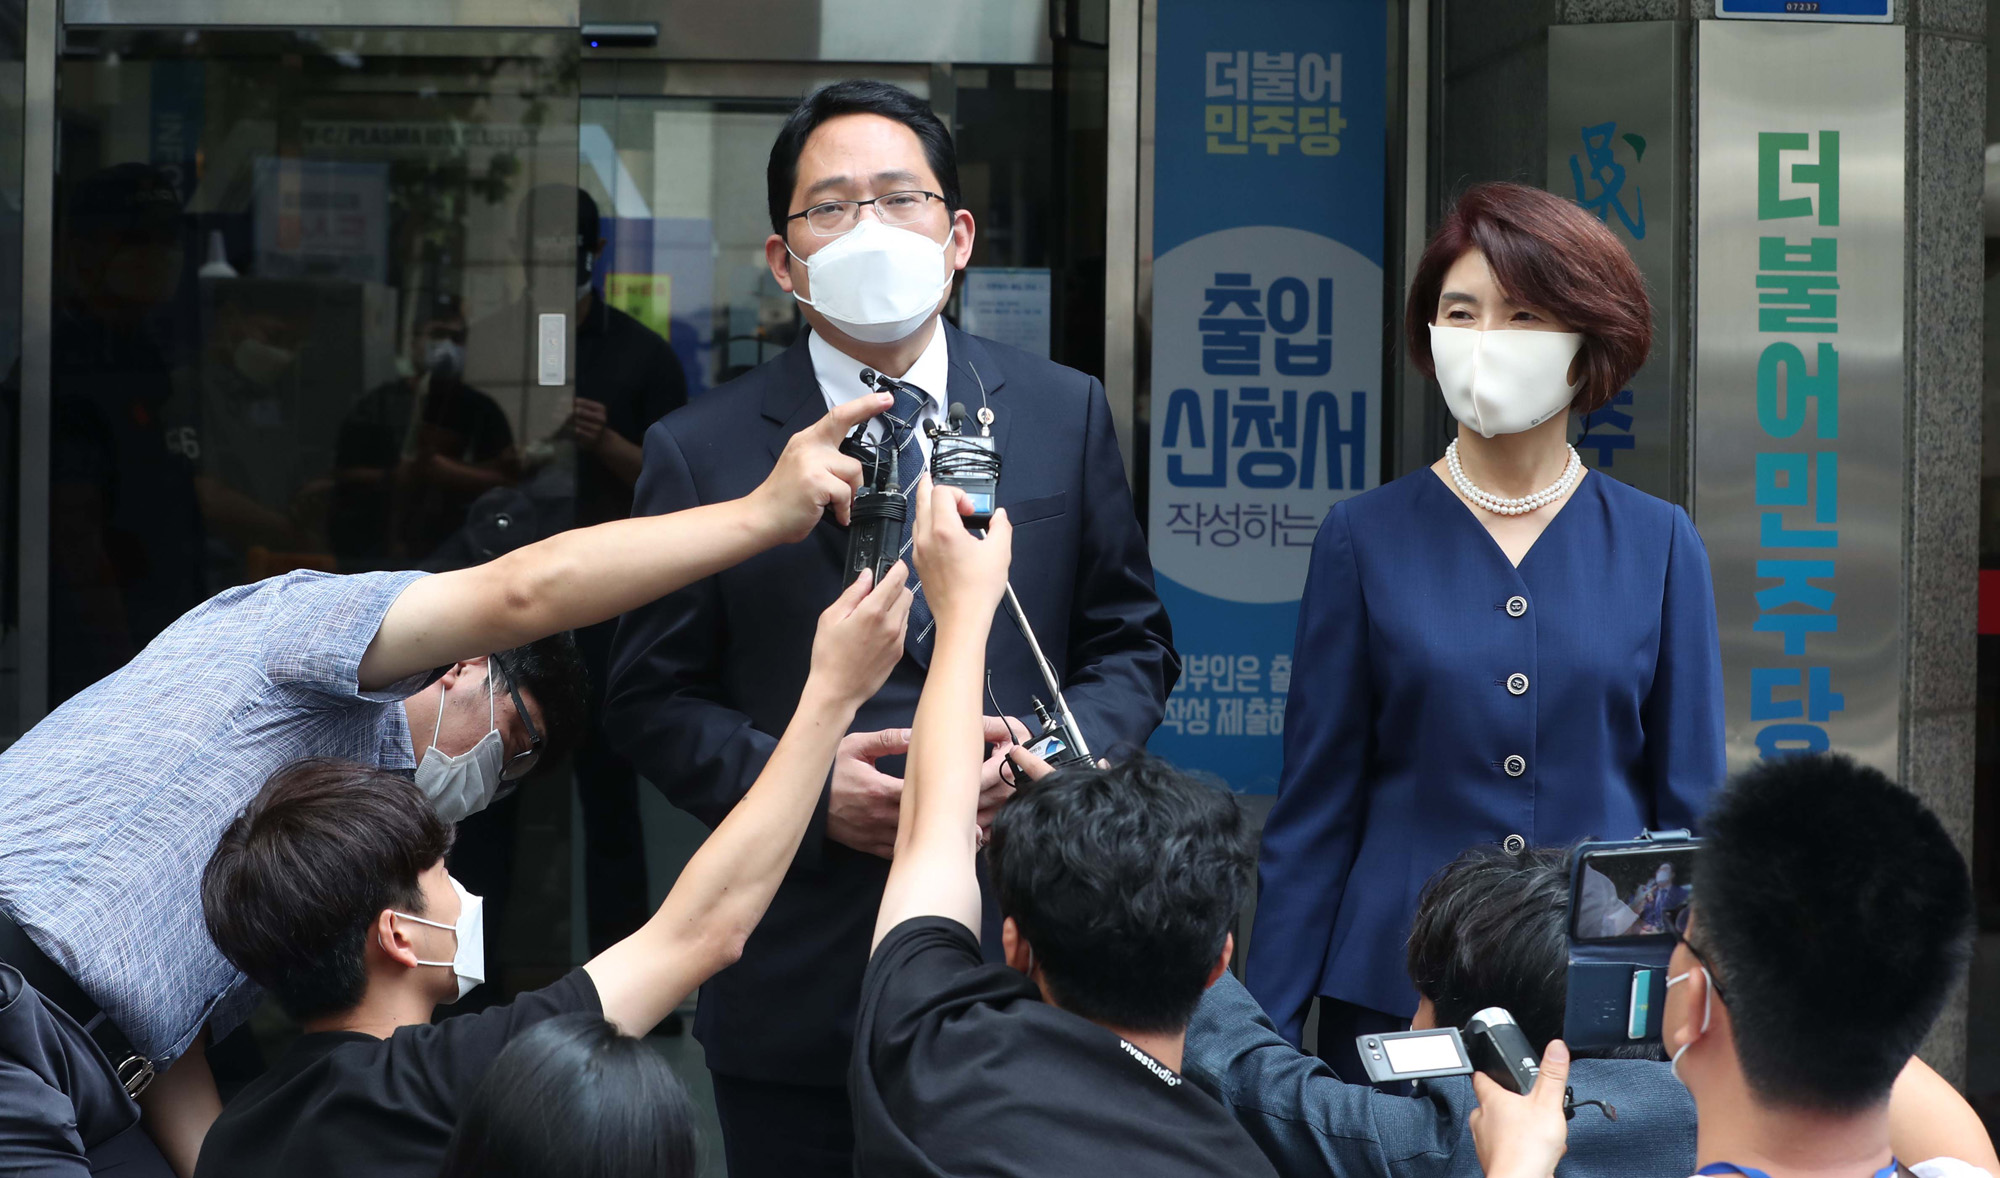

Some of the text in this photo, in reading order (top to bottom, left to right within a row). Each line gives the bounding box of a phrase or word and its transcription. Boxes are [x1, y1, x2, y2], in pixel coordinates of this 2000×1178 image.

[1786, 3, 1818, 12] 07237
[1205, 51, 1342, 102] 더불어
[1205, 105, 1347, 156] 민주당
[1198, 273, 1333, 377] 출입
[1161, 387, 1367, 491] 신청서
[1750, 130, 1845, 762] 더불어민주당
[1166, 503, 1318, 547] 작성하는
[1163, 697, 1210, 735] 작성
